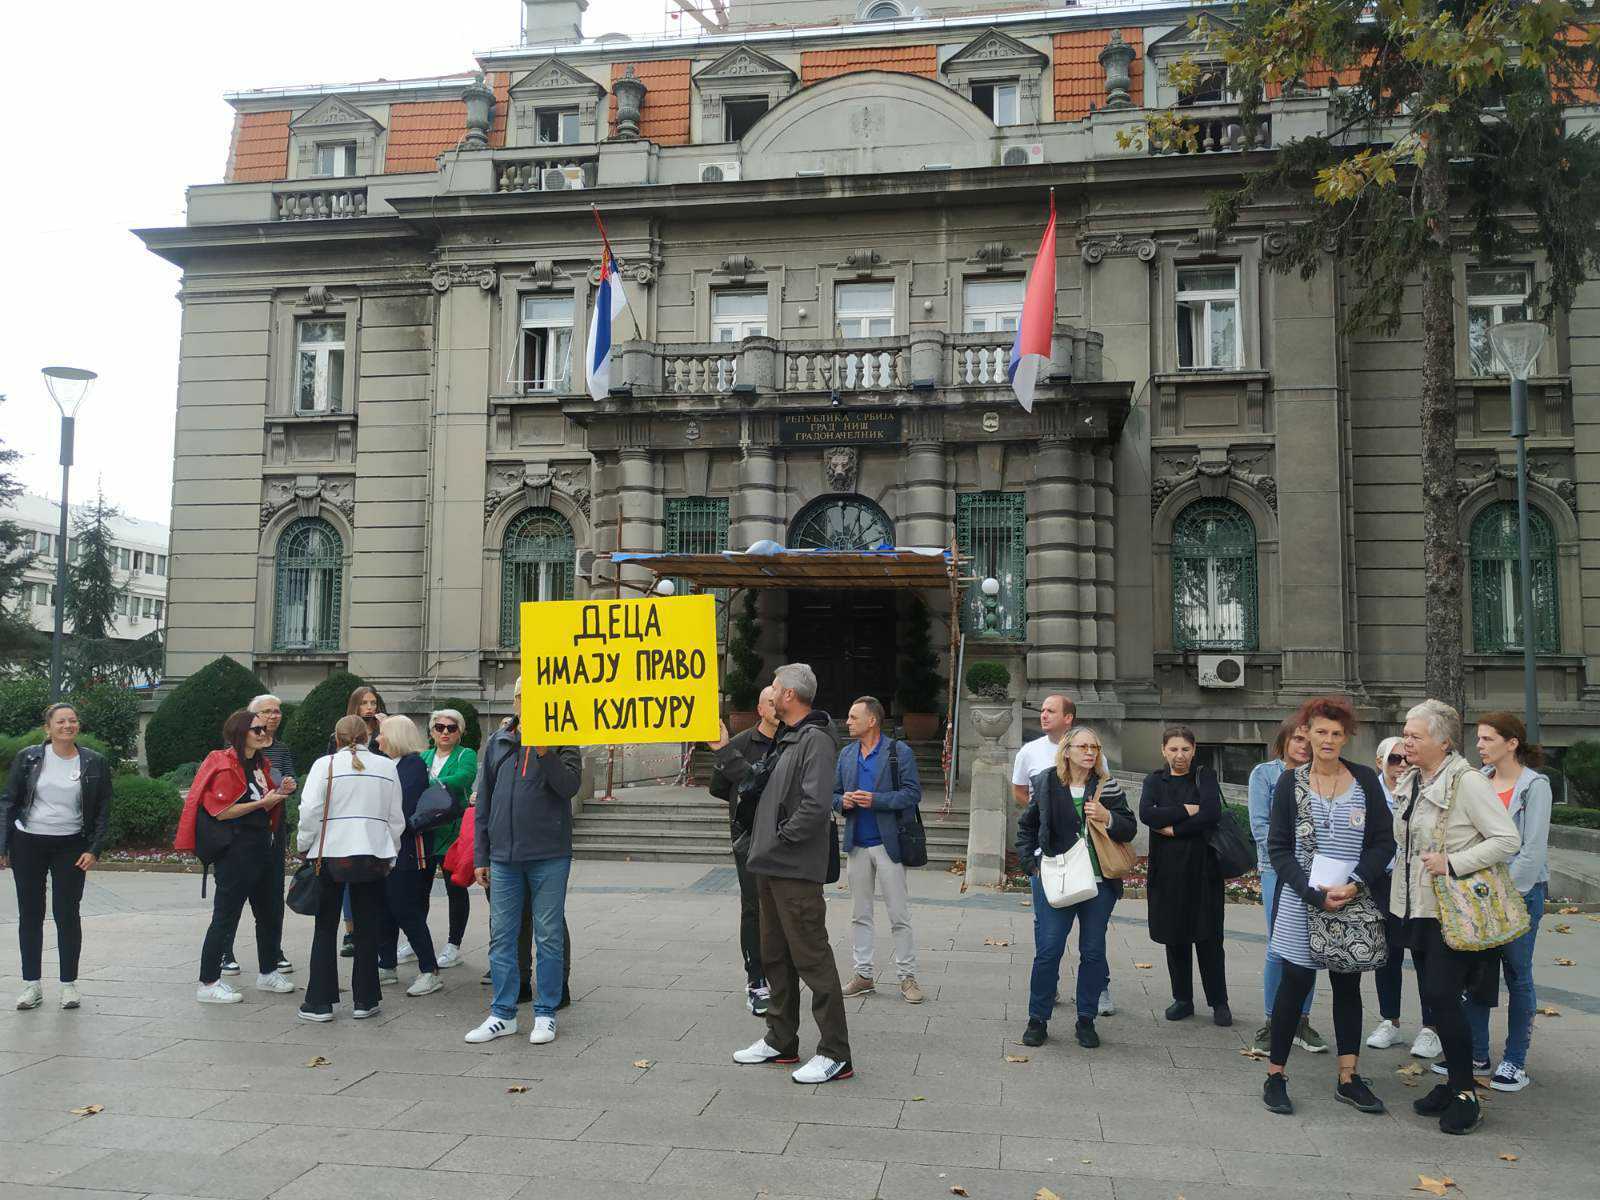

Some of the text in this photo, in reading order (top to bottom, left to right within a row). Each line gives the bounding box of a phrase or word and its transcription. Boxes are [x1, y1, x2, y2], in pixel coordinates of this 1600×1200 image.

[785, 412, 895, 423] РЕПУБЛИКА СРБИЈА
[810, 422, 869, 432] ГРАД НИШ
[795, 430, 885, 440] ГРАДОНАЧЕЛНИК
[573, 603, 661, 646] ДЕЦА
[537, 648, 706, 685] ИМАЈУ ПРАВО
[544, 695, 695, 732] НА КУЛТУРУ
